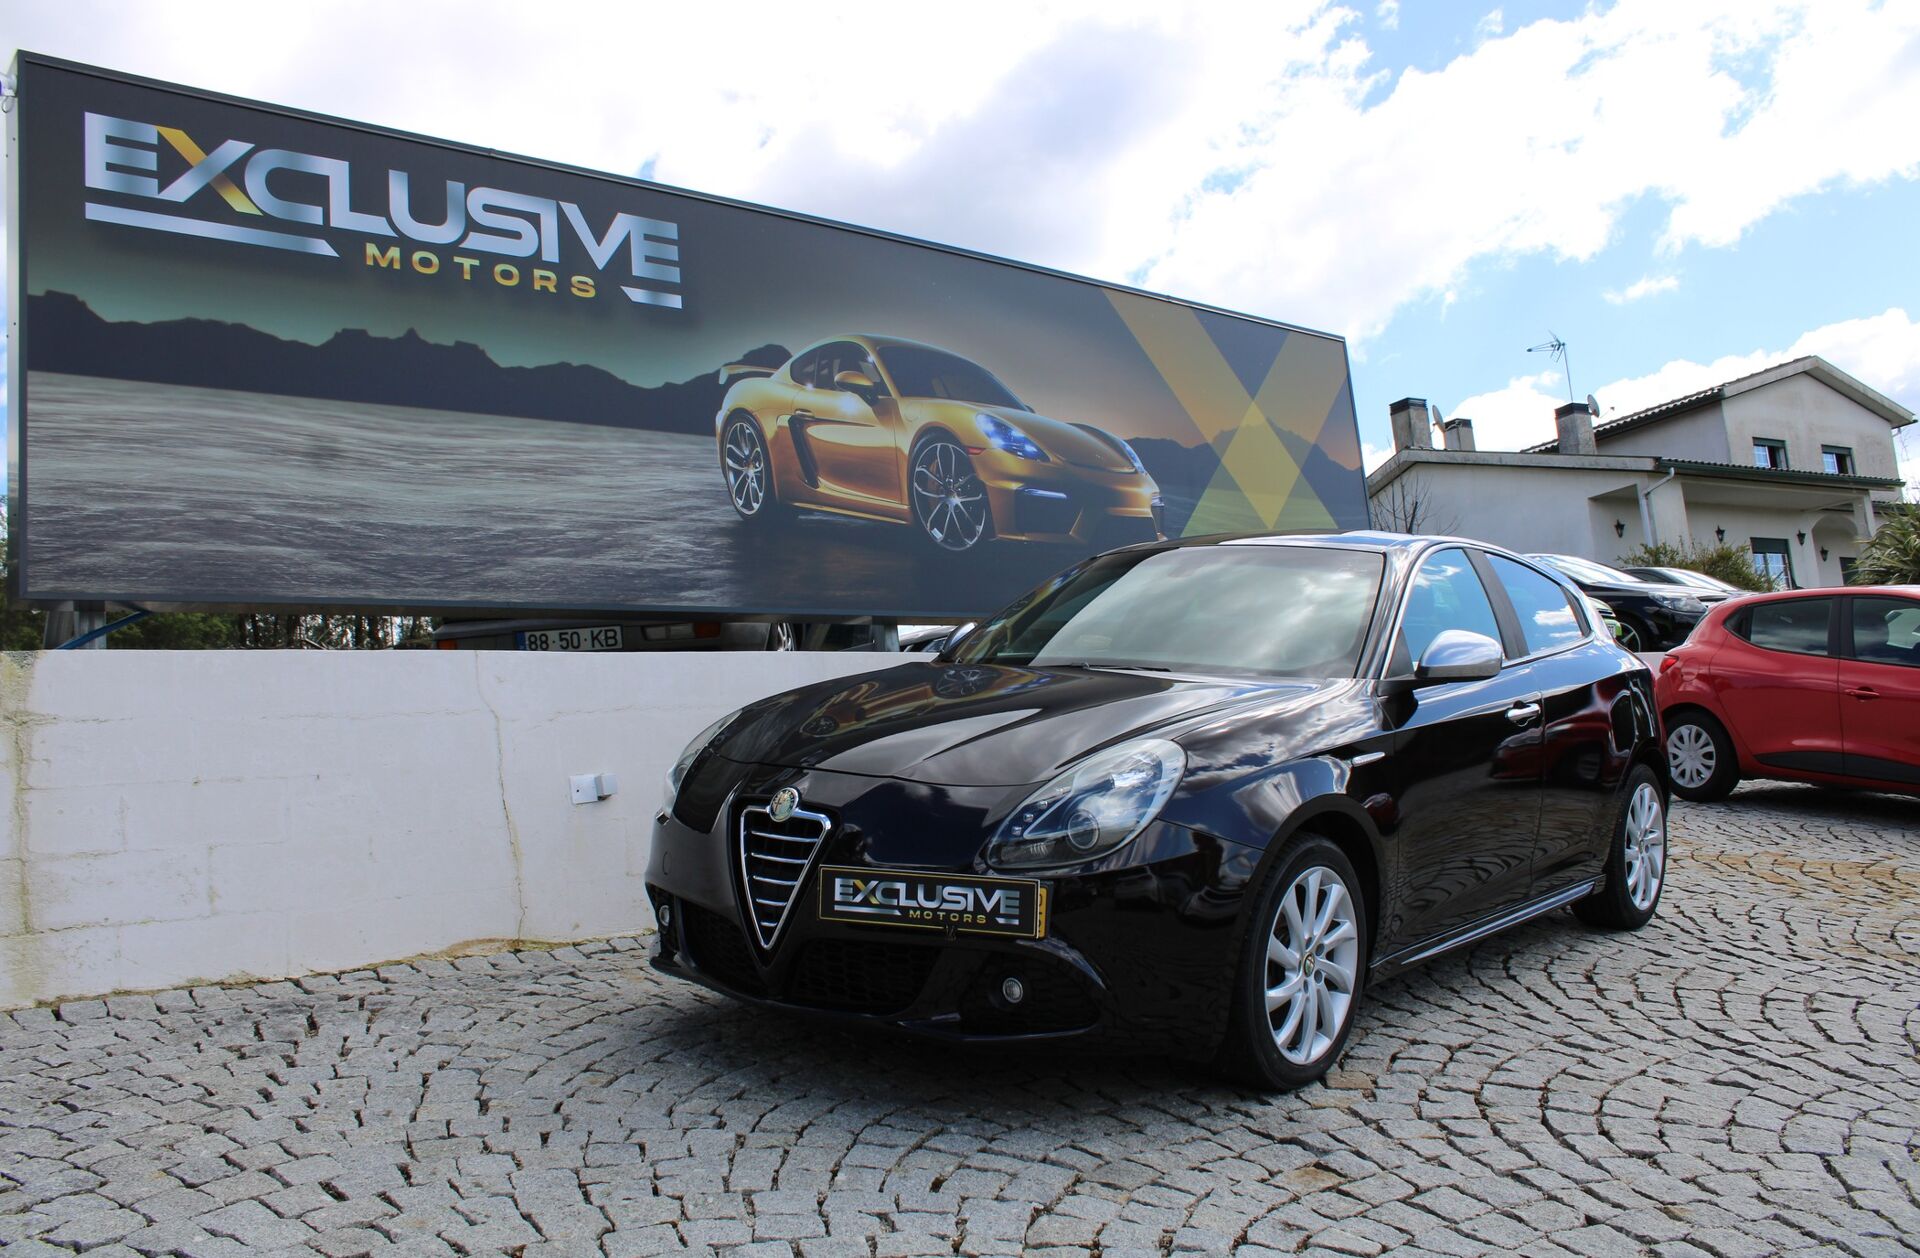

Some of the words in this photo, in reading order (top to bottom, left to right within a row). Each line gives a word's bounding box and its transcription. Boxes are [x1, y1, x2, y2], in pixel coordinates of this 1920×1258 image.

[84, 112, 681, 284] EXCLUSIVE
[365, 242, 596, 298] MOTORS
[834, 877, 1020, 914] EXCLUSIVE
[909, 909, 987, 924] MOTORS
